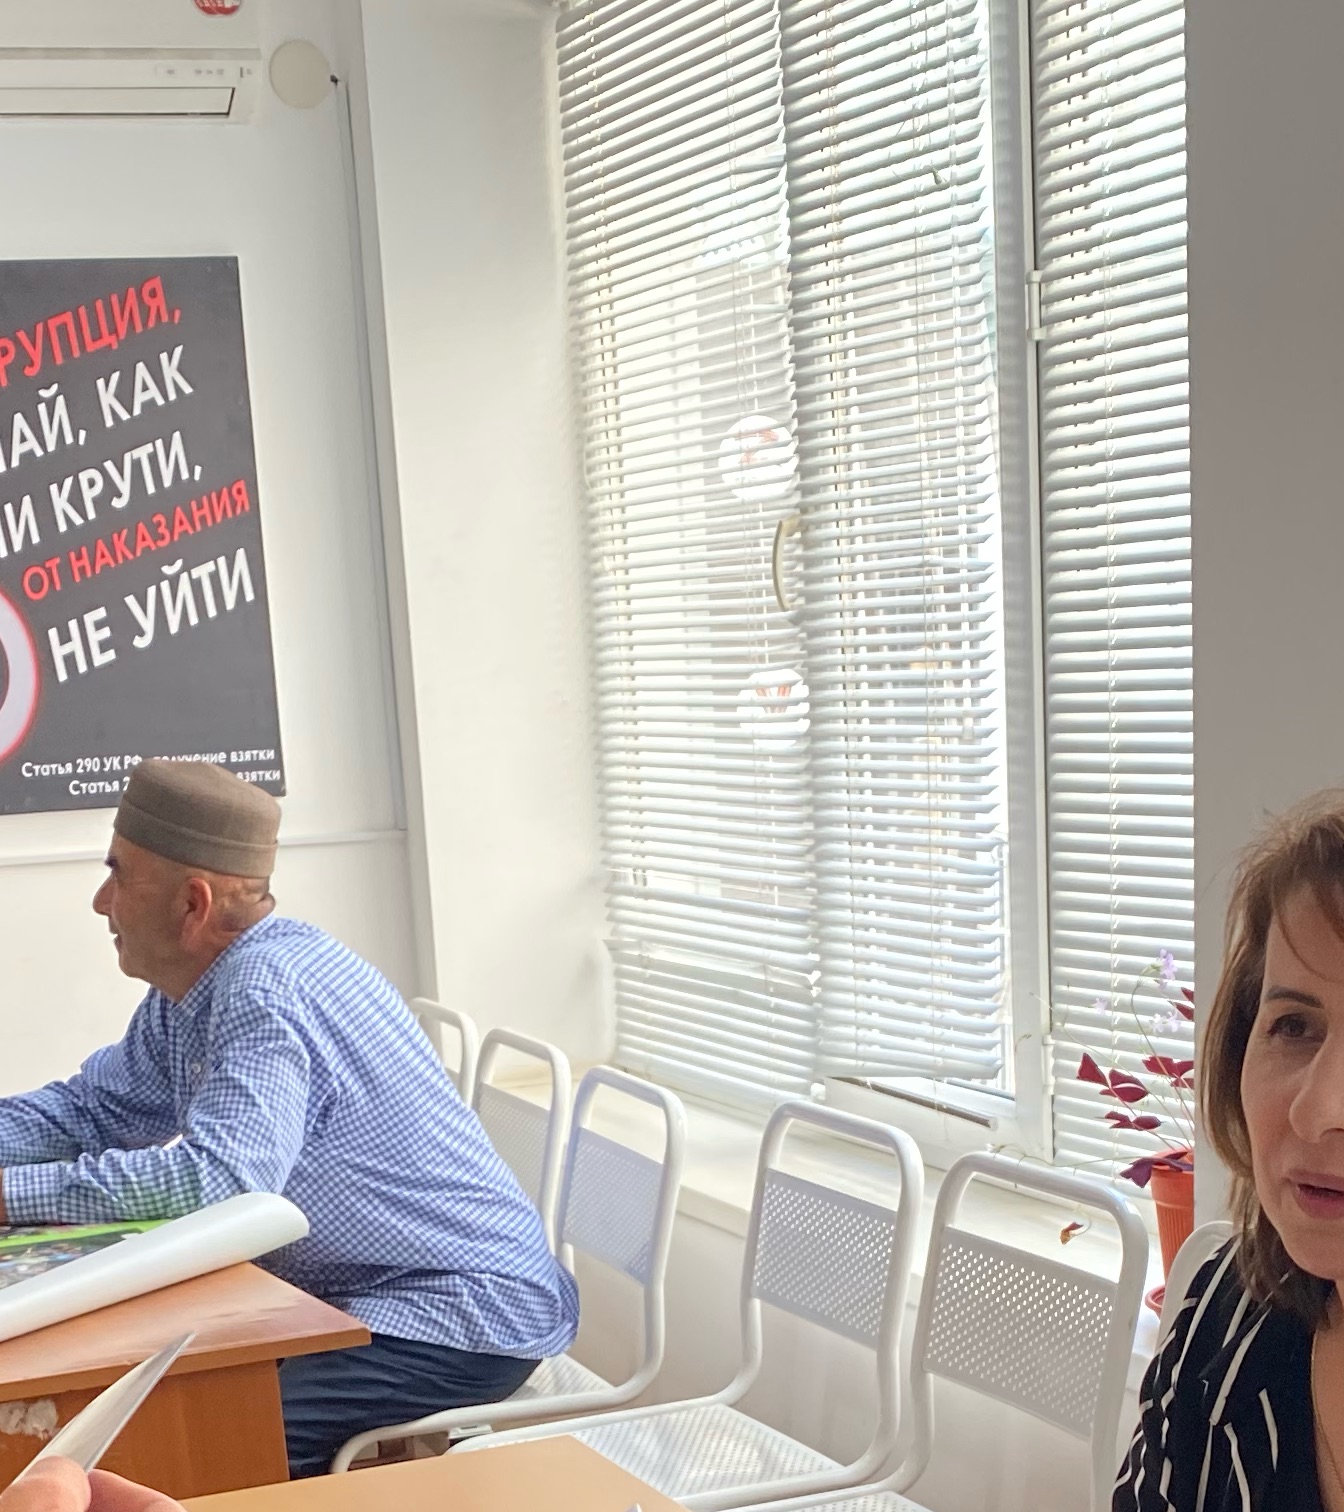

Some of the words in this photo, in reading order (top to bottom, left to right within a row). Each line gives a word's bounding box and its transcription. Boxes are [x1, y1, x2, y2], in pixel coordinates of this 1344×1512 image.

[95, 344, 194, 429] КАК
[49, 430, 202, 533] КРУТИ,
[21, 556, 63, 601] ОТ
[68, 479, 251, 584] НАКАЗАНИЯ
[47, 606, 117, 683] НЕ
[123, 547, 255, 649] УЙТИ
[21, 762, 73, 778] Статья
[76, 757, 100, 774] 290
[103, 755, 122, 773] УК
[229, 749, 275, 763] взятки
[68, 779, 119, 796] Статья
